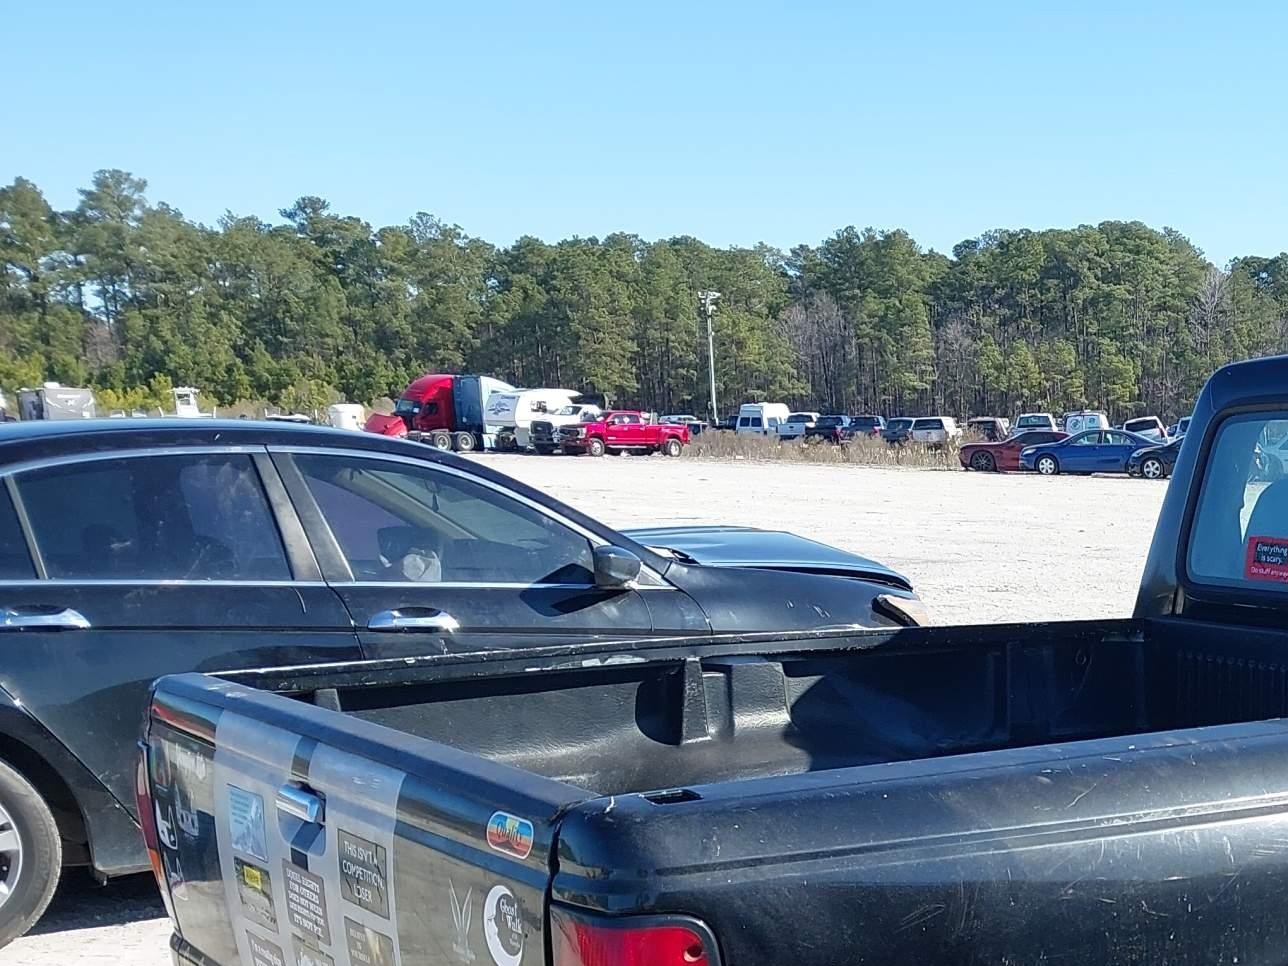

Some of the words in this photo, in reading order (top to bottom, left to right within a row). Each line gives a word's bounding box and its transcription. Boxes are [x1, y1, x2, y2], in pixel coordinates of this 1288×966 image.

[1257, 543, 1288, 557] Everything
[1251, 566, 1259, 574] Do
[344, 841, 357, 857] THIS
[342, 860, 385, 890] COMPETITION,
[353, 883, 373, 904] LOSER
[302, 918, 313, 932] NOT
[506, 914, 523, 934] Walk
